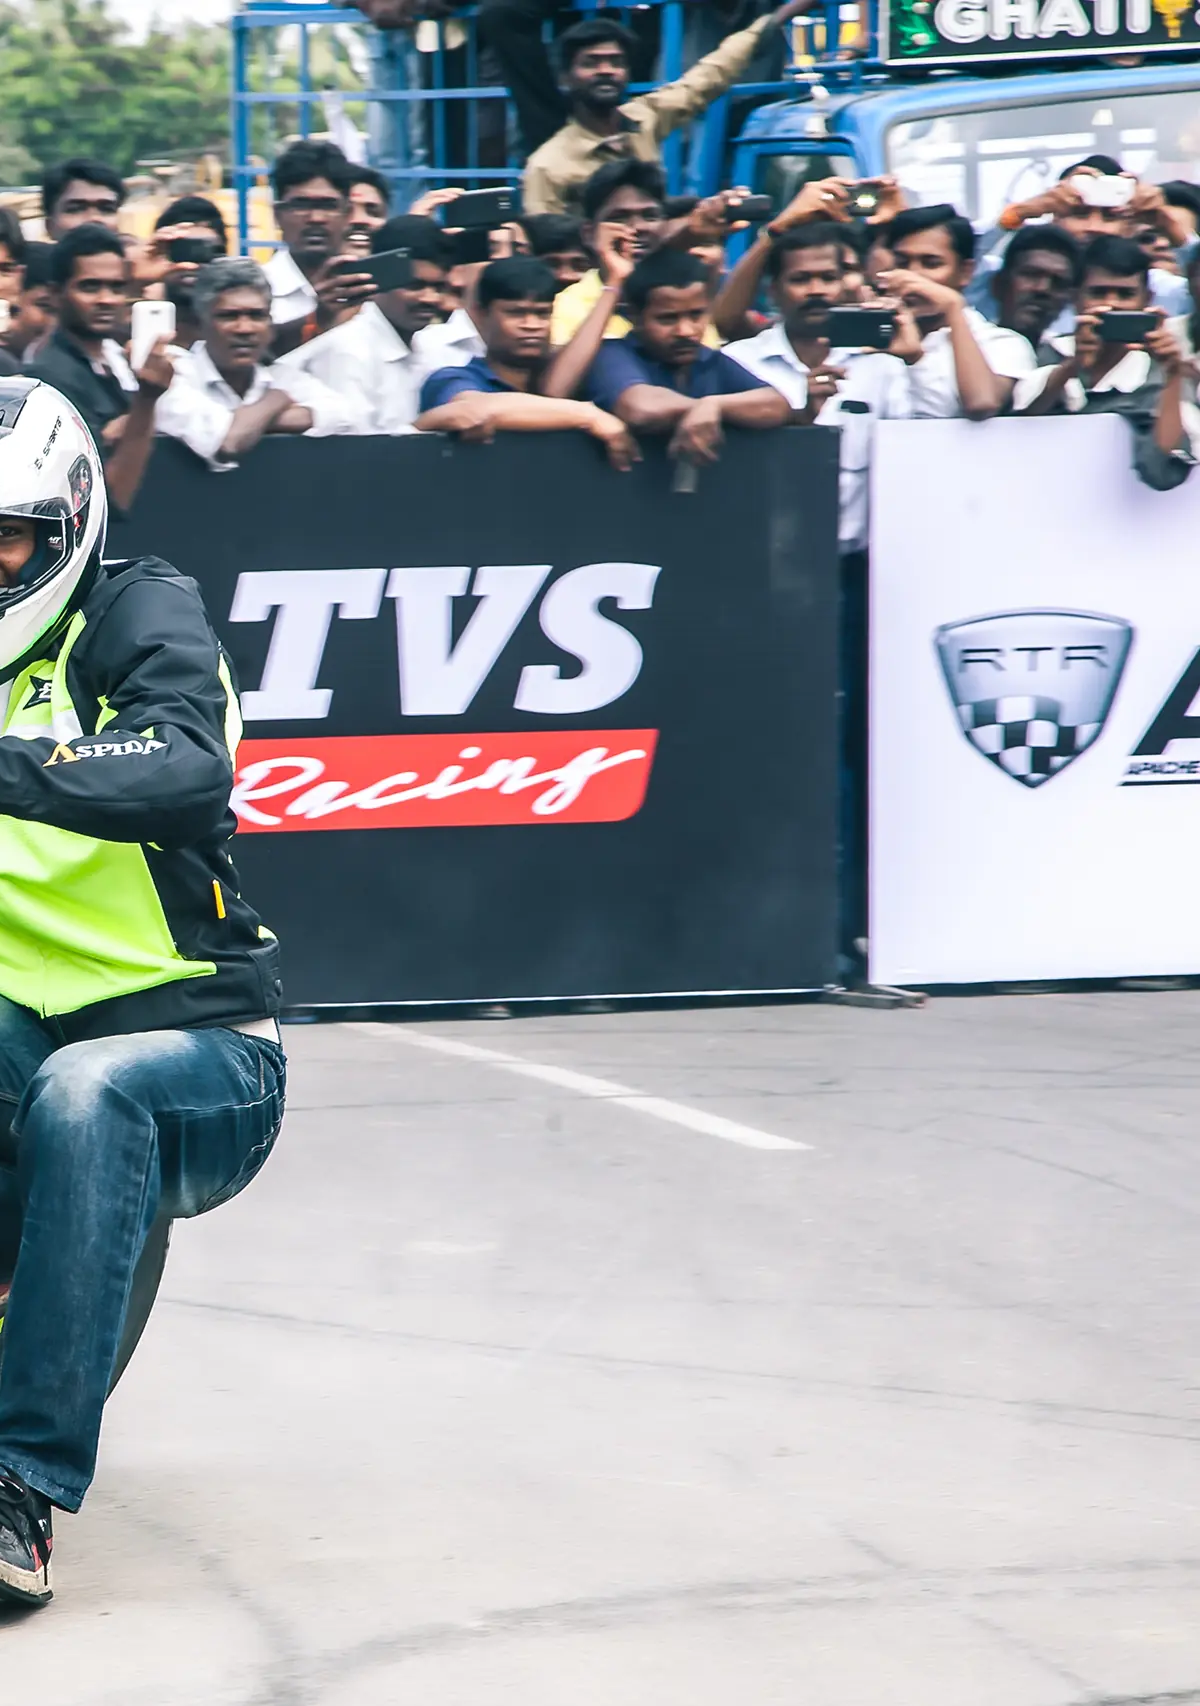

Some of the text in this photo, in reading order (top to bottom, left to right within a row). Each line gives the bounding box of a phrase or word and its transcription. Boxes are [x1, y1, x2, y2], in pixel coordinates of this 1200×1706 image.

[228, 562, 662, 721] TVS
[958, 644, 1108, 674] RTR
[228, 746, 647, 826] Racing
